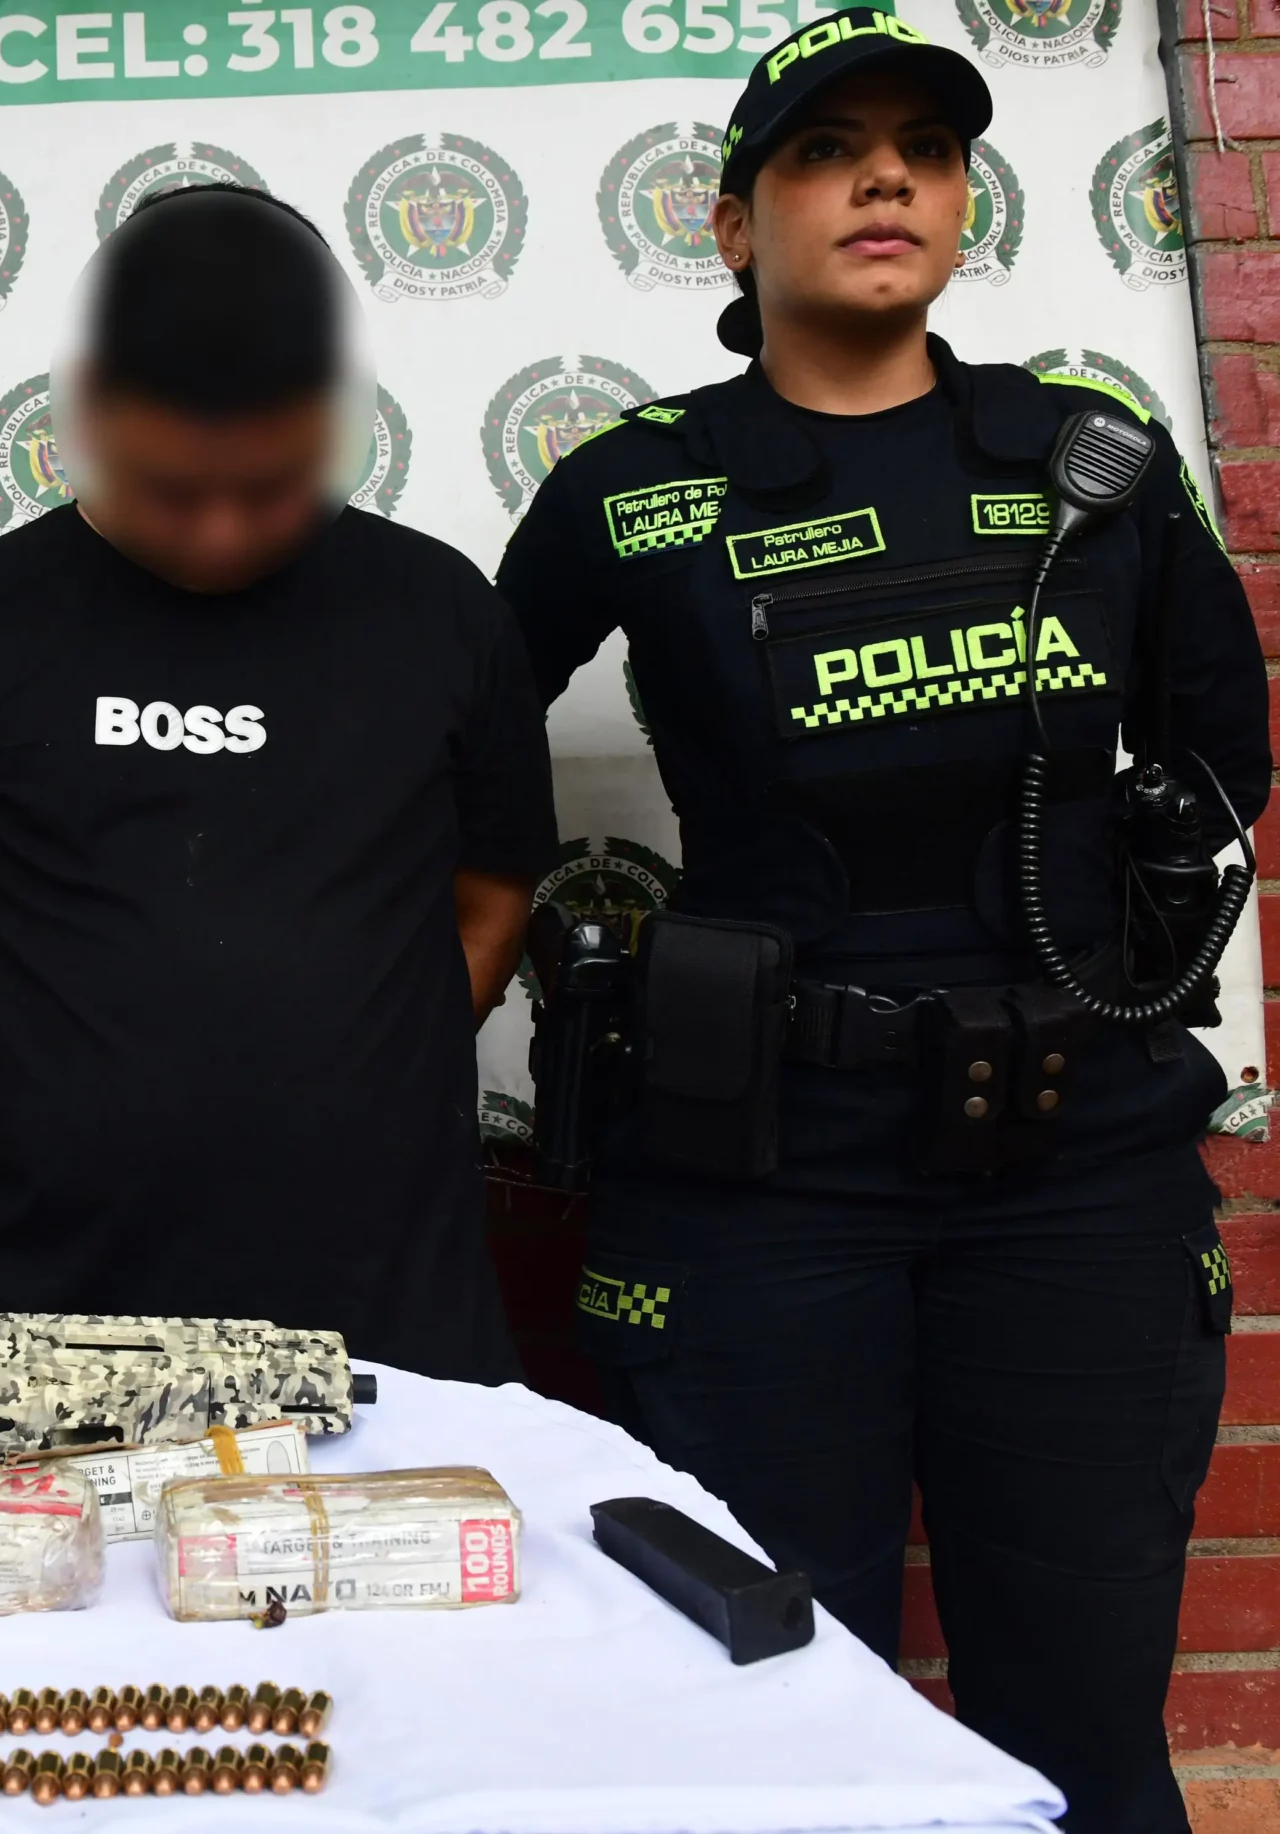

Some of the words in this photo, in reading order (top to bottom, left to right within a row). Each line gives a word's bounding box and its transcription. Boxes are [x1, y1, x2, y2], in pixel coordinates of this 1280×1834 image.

[226, 5, 380, 72] 318
[410, 0, 592, 63] 482
[1043, 10, 1100, 49] NACIONAL
[767, 11, 930, 85] POLIC
[999, 45, 1029, 64] DIOS
[1044, 45, 1089, 65] PATRIA
[680, 140, 698, 149] DE
[177, 161, 196, 170] DE
[427, 152, 445, 161] DE
[461, 158, 506, 223] COLOMBIA
[970, 155, 1004, 214] OLOMBIA
[441, 238, 501, 281] NACIONAL
[952, 262, 992, 278] PATRIA
[649, 267, 682, 285] DIOS
[696, 271, 733, 286] PATRI
[1142, 267, 1177, 280] DIOS
[393, 278, 426, 295] DIOS
[441, 276, 487, 296] PATRIA
[565, 375, 584, 384] DE
[1070, 368, 1087, 377] DE
[1107, 424, 1147, 446] MOTOROLA
[616, 491, 680, 516] Patrullero
[685, 486, 703, 500] de
[622, 508, 683, 536] LAURA
[983, 503, 1050, 526] 18129
[764, 524, 842, 548] Patrullero
[751, 549, 809, 569] LAURA
[813, 537, 863, 558] MEJIA
[814, 605, 1080, 695] POLICÍA
[95, 696, 267, 754] BOSS
[590, 858, 611, 869] DE
[108, 1465, 115, 1474] &
[263, 1537, 324, 1554] TARGE
[465, 1530, 490, 1593] 100
[491, 1523, 509, 1598] ROUNDS
[266, 1579, 356, 1604] NAO
[420, 1582, 450, 1597] FMJ
